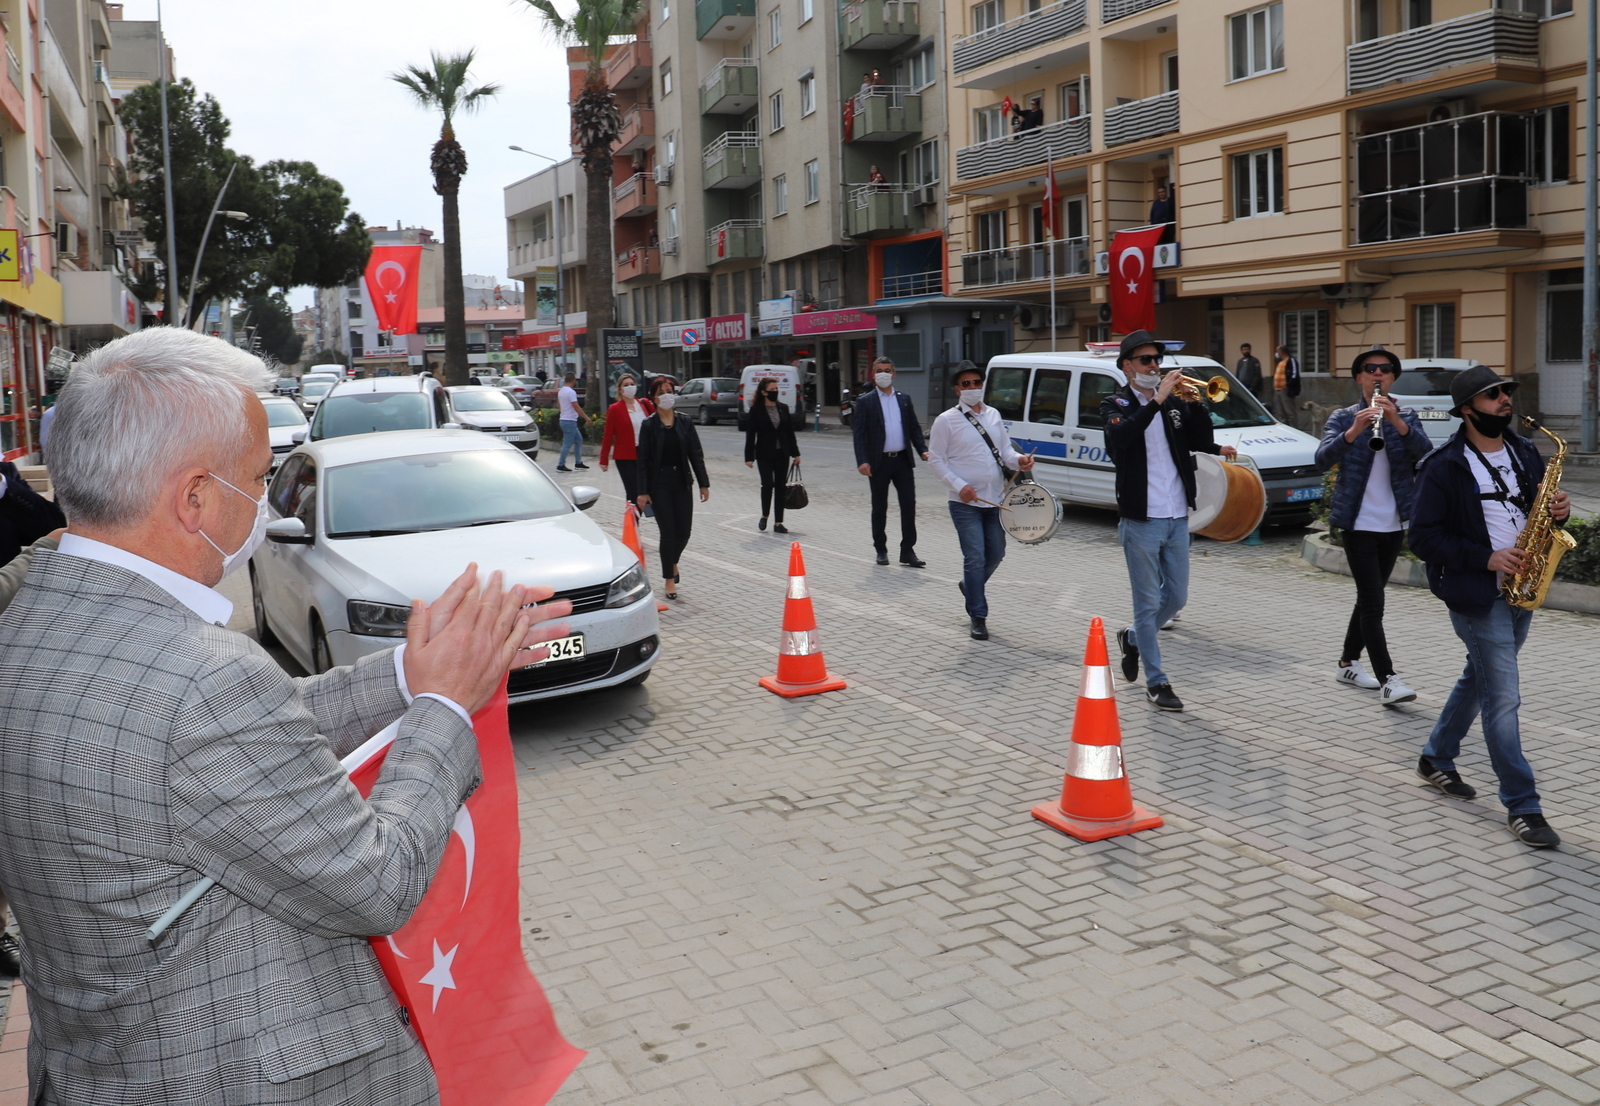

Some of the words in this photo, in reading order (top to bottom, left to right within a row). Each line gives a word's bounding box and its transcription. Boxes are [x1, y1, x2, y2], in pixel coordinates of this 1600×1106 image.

[715, 320, 743, 340] ALTUS
[1241, 436, 1298, 446] POLİS
[1077, 445, 1112, 464] POL
[1292, 491, 1302, 500] 45
[1303, 489, 1310, 499] A
[544, 638, 582, 659] 345
